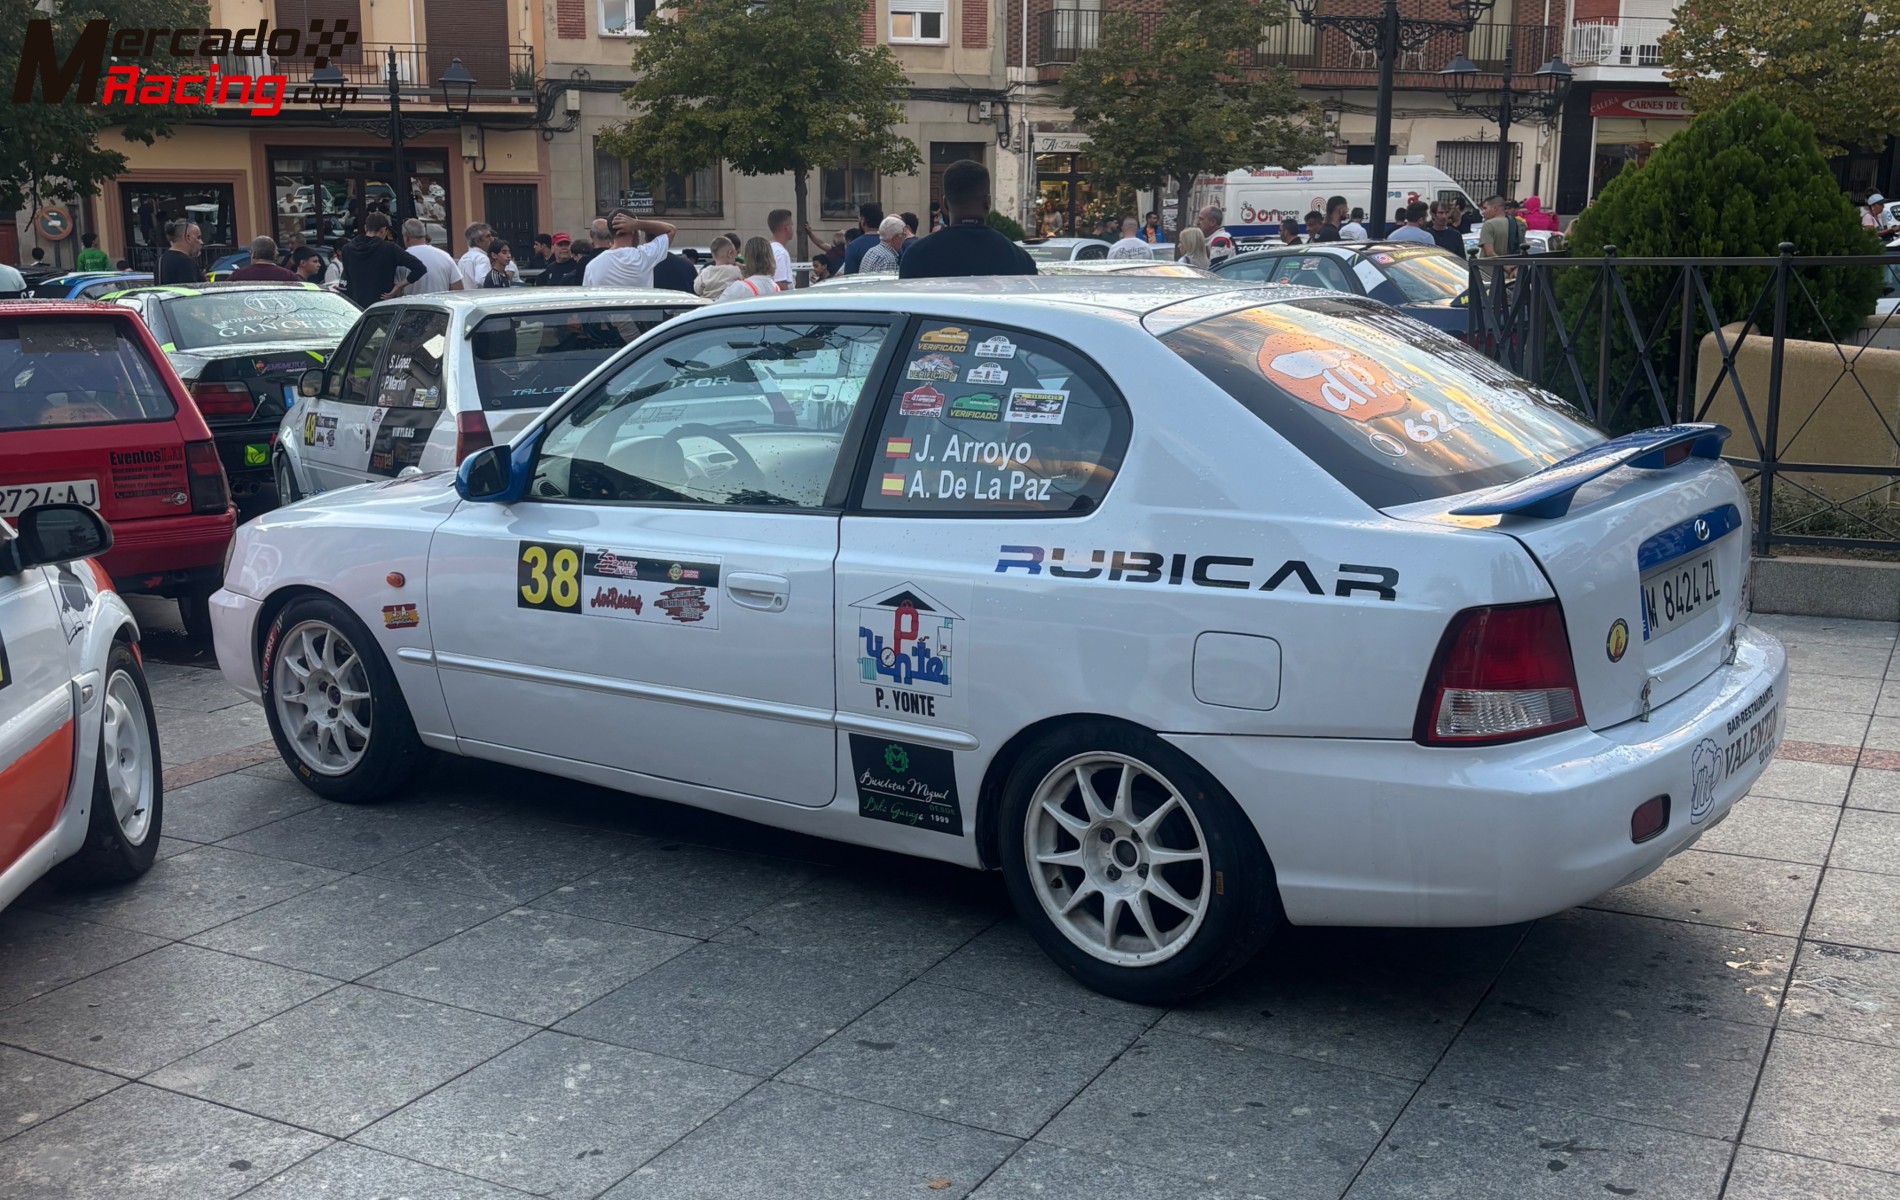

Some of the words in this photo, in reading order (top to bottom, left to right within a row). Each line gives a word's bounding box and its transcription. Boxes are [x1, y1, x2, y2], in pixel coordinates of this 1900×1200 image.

[1628, 100, 1664, 110] CARNES
[1666, 101, 1679, 110] DE
[918, 343, 966, 353] VERIFICADO
[909, 370, 956, 381] VERIFICADO
[304, 413, 317, 445] 48
[900, 409, 940, 418] VERIFICADO
[950, 409, 999, 421] VERIFICADO
[109, 450, 162, 466] Eventos
[914, 434, 935, 463] J.
[941, 434, 1032, 470] Arroyo
[908, 469, 930, 499] A.
[938, 470, 967, 500] De
[974, 470, 1001, 500] La
[1008, 472, 1053, 501] Paz
[520, 545, 579, 608] 38
[994, 544, 1400, 602] RUBICAR
[1645, 585, 1658, 632] M
[1662, 566, 1702, 622] 8424
[1702, 558, 1720, 602] ZL
[875, 687, 890, 710] P.
[892, 689, 936, 717] YONTE
[1727, 685, 1774, 736] BAR-RESTAURANTE
